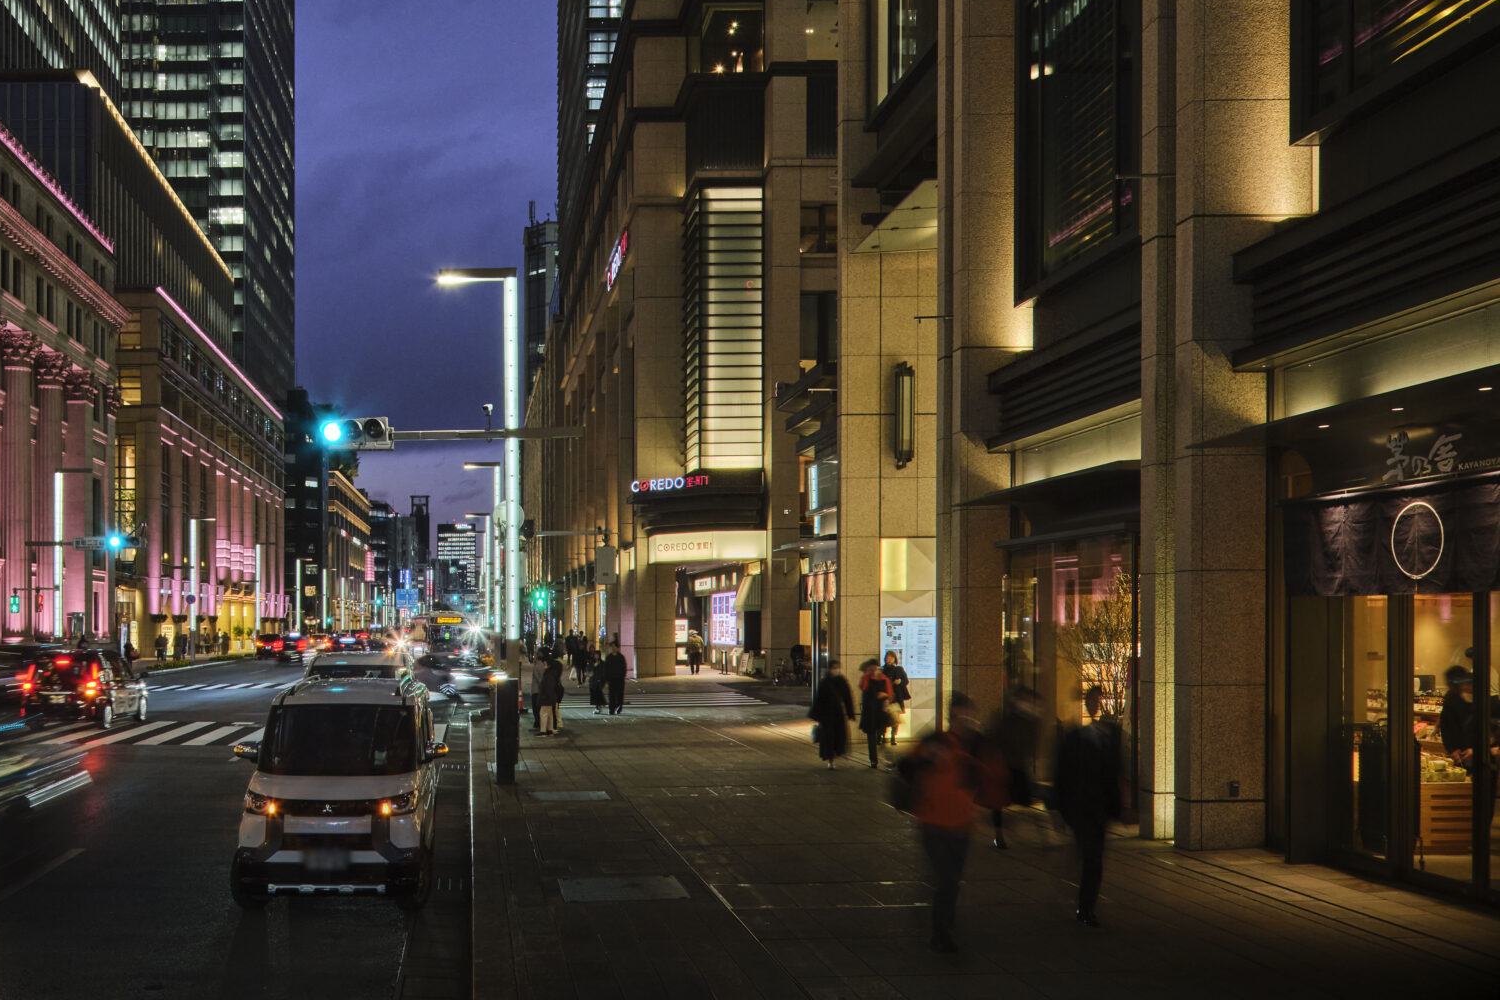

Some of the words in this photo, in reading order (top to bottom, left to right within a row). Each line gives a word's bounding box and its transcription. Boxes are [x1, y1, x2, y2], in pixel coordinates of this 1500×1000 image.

[1457, 456, 1500, 472] KAYANOYA
[631, 476, 685, 493] COREDO
[657, 542, 695, 552] COREDO
